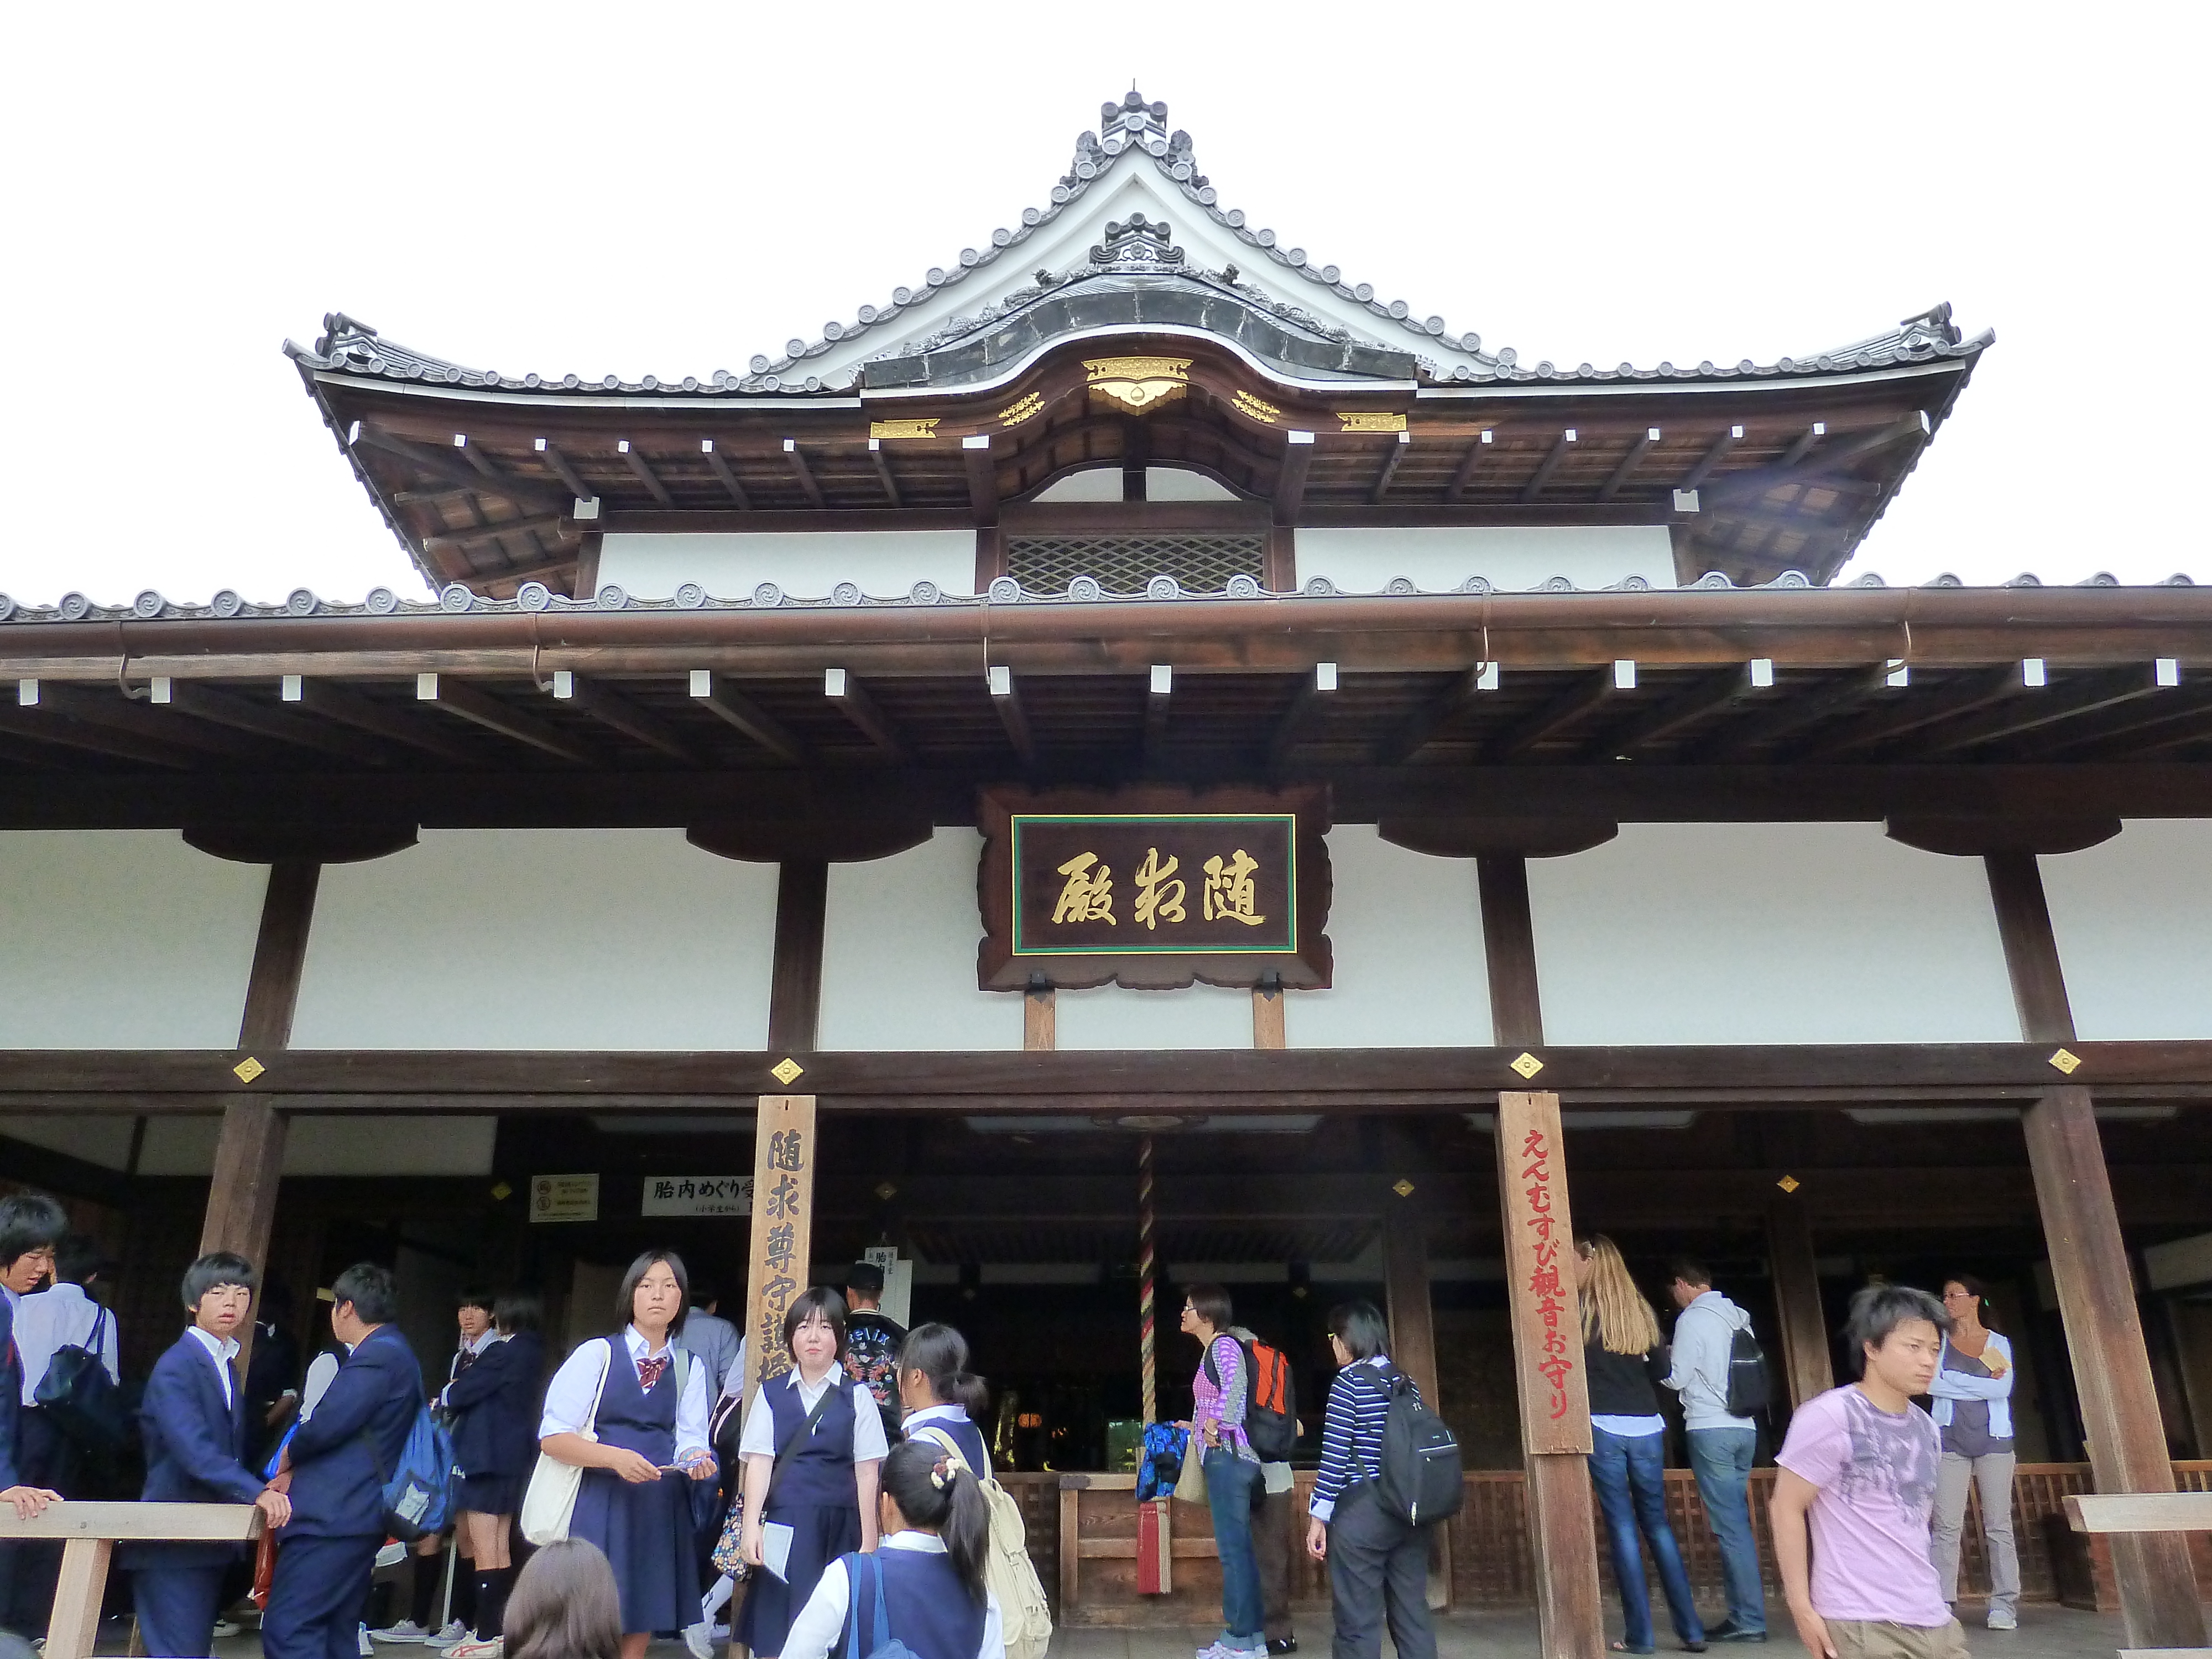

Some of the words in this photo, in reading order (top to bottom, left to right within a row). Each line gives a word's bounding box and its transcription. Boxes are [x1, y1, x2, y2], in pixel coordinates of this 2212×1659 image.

[1521, 1129, 1572, 1419] えんむすび観音お守り
